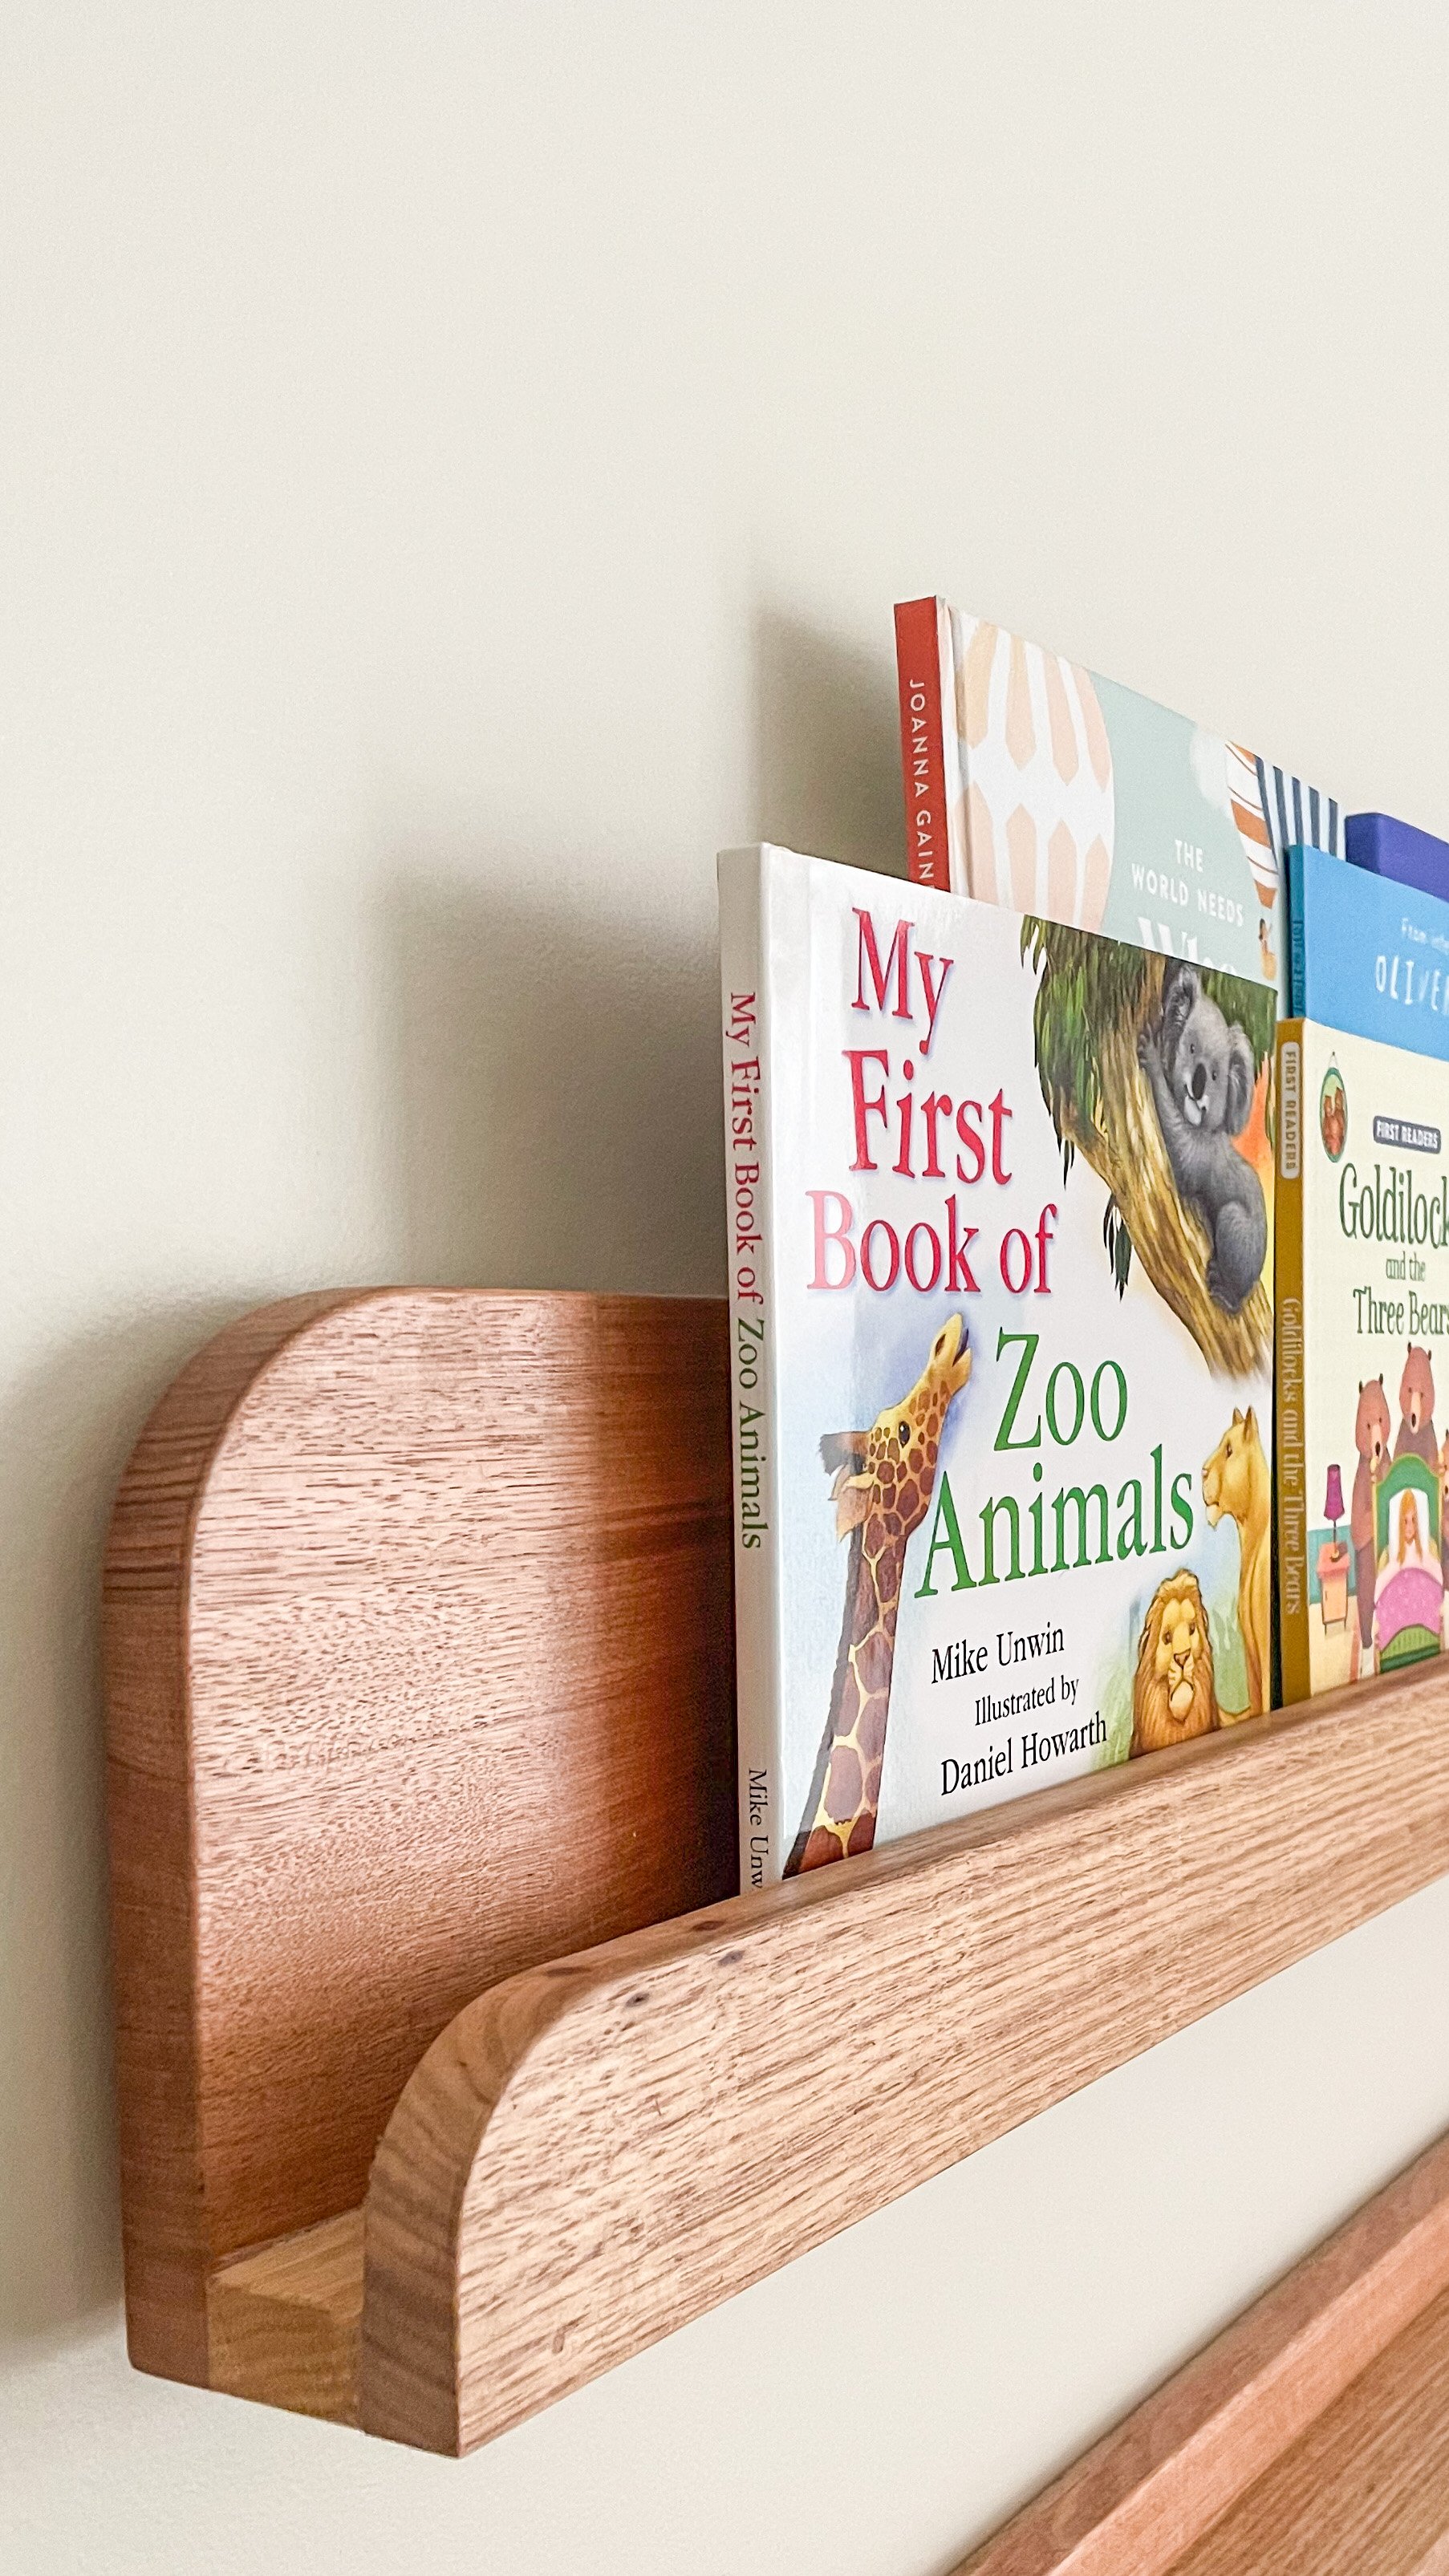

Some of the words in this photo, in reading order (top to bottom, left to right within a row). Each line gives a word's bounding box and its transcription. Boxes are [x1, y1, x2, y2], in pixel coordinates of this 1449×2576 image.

[909, 678, 929, 797] JOANNA
[916, 809, 936, 888] GAIN
[1174, 839, 1203, 873] THE
[1131, 862, 1189, 907] WORLD
[1197, 887, 1244, 927] NEEDS
[851, 907, 954, 1055] My
[725, 992, 757, 1048] My
[731, 1055, 761, 1152] First
[1285, 1050, 1297, 1093] FIRST
[842, 1049, 1013, 1186] First
[1285, 1099, 1297, 1170] READERS
[1375, 1119, 1398, 1142] FIRST
[1401, 1123, 1439, 1149] READERS
[734, 1162, 763, 1256] Book
[805, 1190, 981, 1293] Book
[1000, 1203, 1057, 1294] of
[1385, 1250, 1406, 1280] and
[1409, 1251, 1427, 1282] the
[737, 1266, 764, 1306] of
[1352, 1285, 1405, 1336] Three
[737, 1317, 765, 1390] Zoo
[1282, 1297, 1303, 1403] Goldilocks
[993, 1325, 1128, 1452] Zoo
[1283, 1409, 1305, 1448] and
[739, 1400, 769, 1550] Animals
[1284, 1453, 1305, 1487] the
[913, 1443, 1195, 1600] Animals
[1284, 1490, 1305, 1553] Three
[1285, 1556, 1305, 1615] Bears
[931, 1639, 988, 1685] Mike
[996, 1621, 1065, 1666] Unwin
[975, 1676, 1056, 1726] Illustrated
[1060, 1673, 1080, 1706] by
[940, 1737, 1013, 1796] Daniel
[1021, 1710, 1107, 1769] Howarth
[749, 1767, 769, 1826] Mike
